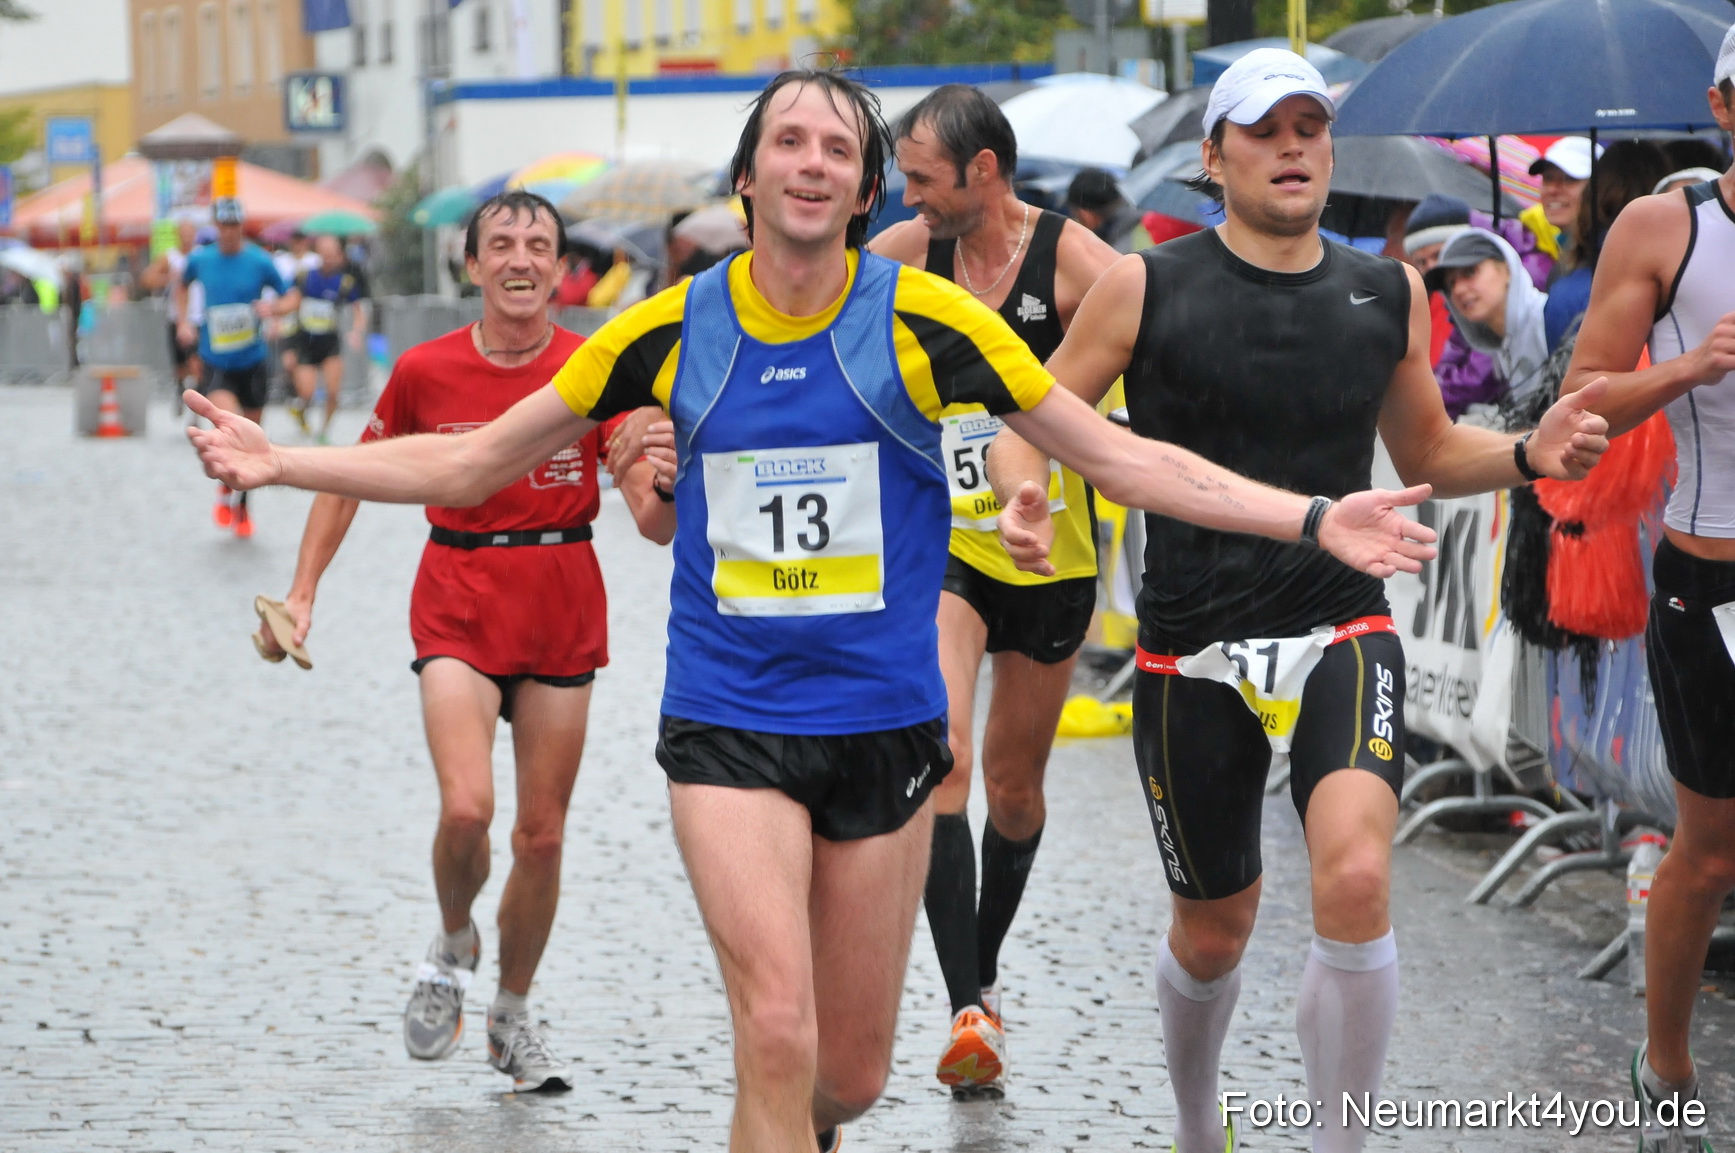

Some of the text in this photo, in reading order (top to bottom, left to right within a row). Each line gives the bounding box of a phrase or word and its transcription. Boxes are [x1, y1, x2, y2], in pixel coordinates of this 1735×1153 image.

[775, 366, 807, 381] asics
[960, 416, 1004, 434] BOC
[755, 458, 827, 478] BOCK
[954, 441, 990, 490] 5
[759, 493, 830, 553] 13
[773, 567, 819, 590] Götz
[1334, 622, 1370, 639] an 2006
[1221, 640, 1280, 694] 61
[1373, 662, 1394, 743] SKINS
[1153, 800, 1188, 885] SKINS
